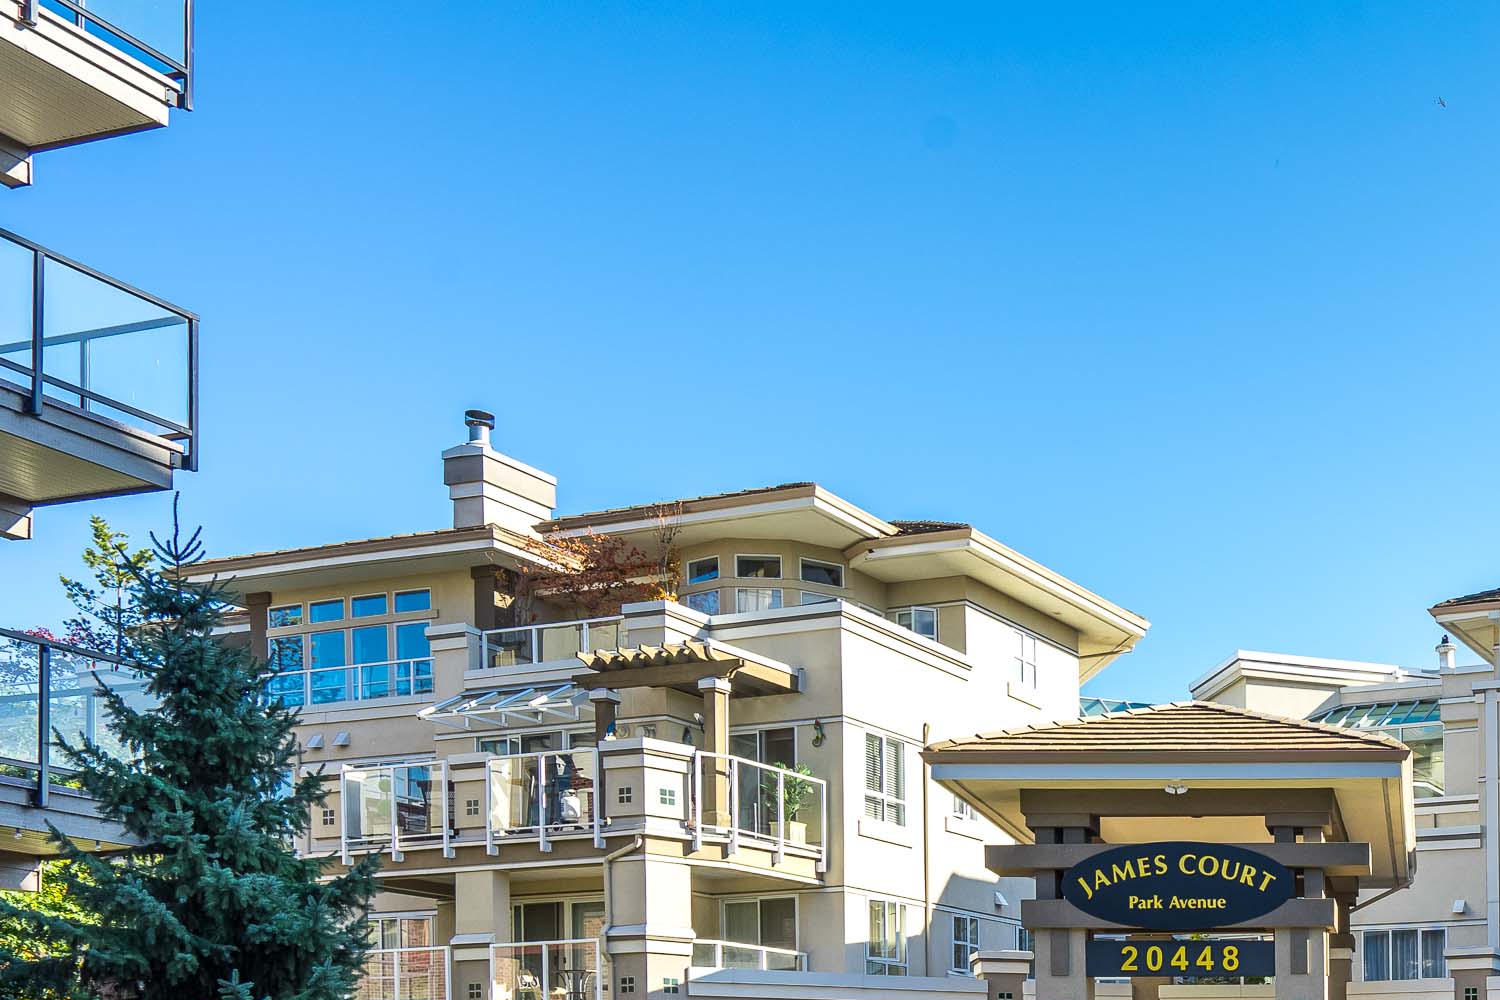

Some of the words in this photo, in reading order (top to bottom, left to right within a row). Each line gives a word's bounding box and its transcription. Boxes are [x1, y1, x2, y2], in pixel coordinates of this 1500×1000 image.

[1078, 854, 1168, 900] JAMES
[1178, 854, 1277, 892] COURT
[1129, 895, 1163, 909] Park
[1169, 895, 1226, 909] Avenue
[1121, 945, 1239, 971] 20448
